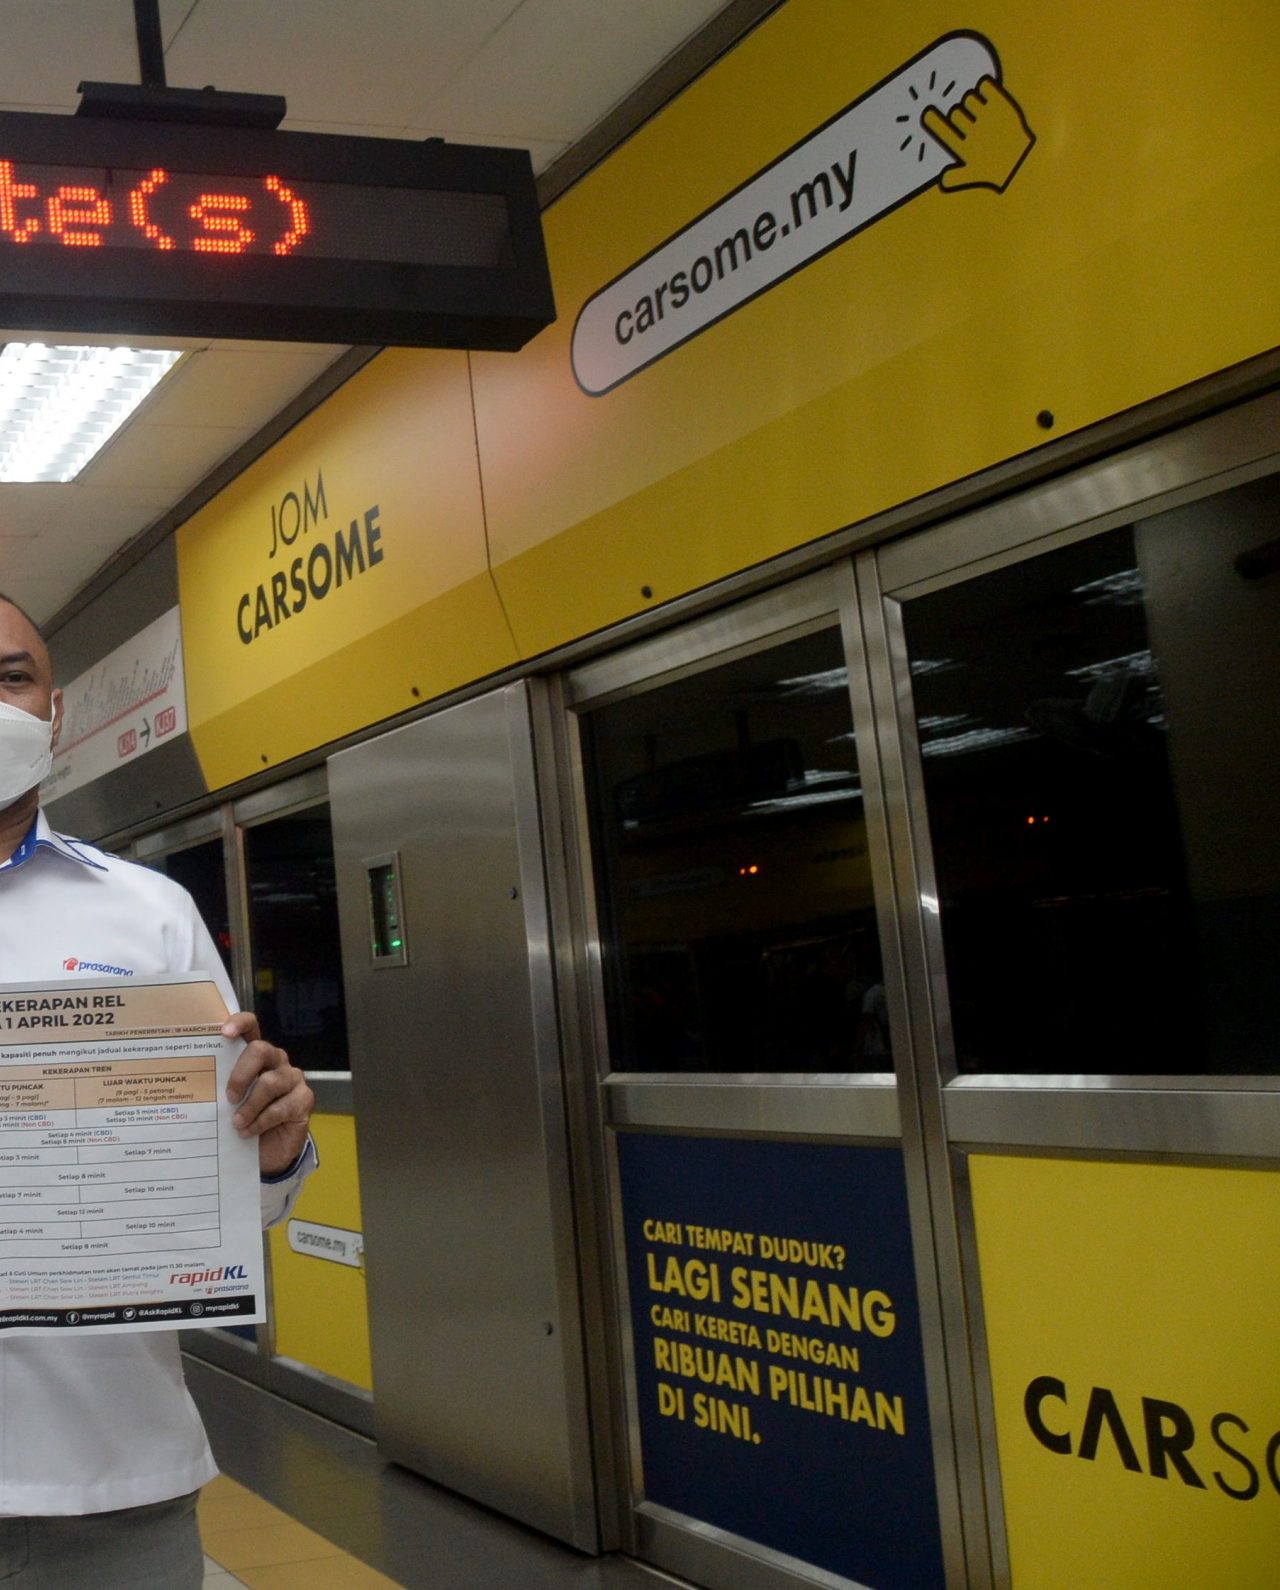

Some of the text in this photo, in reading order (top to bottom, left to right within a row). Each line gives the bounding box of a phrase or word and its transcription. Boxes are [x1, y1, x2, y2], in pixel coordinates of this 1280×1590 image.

[614, 149, 858, 345] carsome.my
[269, 468, 328, 559] JOM
[236, 505, 384, 645] CARSOME
[6, 1017, 12, 1029] 1
[17, 1015, 68, 1029] APRIL
[72, 1012, 115, 1026] 2022
[93, 995, 125, 1008] REL
[1, 1051, 31, 1060] kapasiti
[32, 1050, 57, 1060] penuh
[58, 1048, 96, 1058] mengikut
[97, 1046, 121, 1056] jadual
[122, 1044, 164, 1054] kekerapan
[165, 1042, 192, 1052] seperti
[297, 1231, 346, 1256] carsome.my
[642, 1218, 846, 1271] CARI TEMPAT DUDUK?
[169, 1265, 248, 1286] rapidKL
[646, 1252, 896, 1338] LAGI SENANG
[82, 1312, 116, 1320] @myrapid
[650, 1303, 860, 1374] CARI KERETA DENGAN
[653, 1336, 906, 1437] RIBUAN PILIHAN
[657, 1382, 762, 1445] DI SINI.
